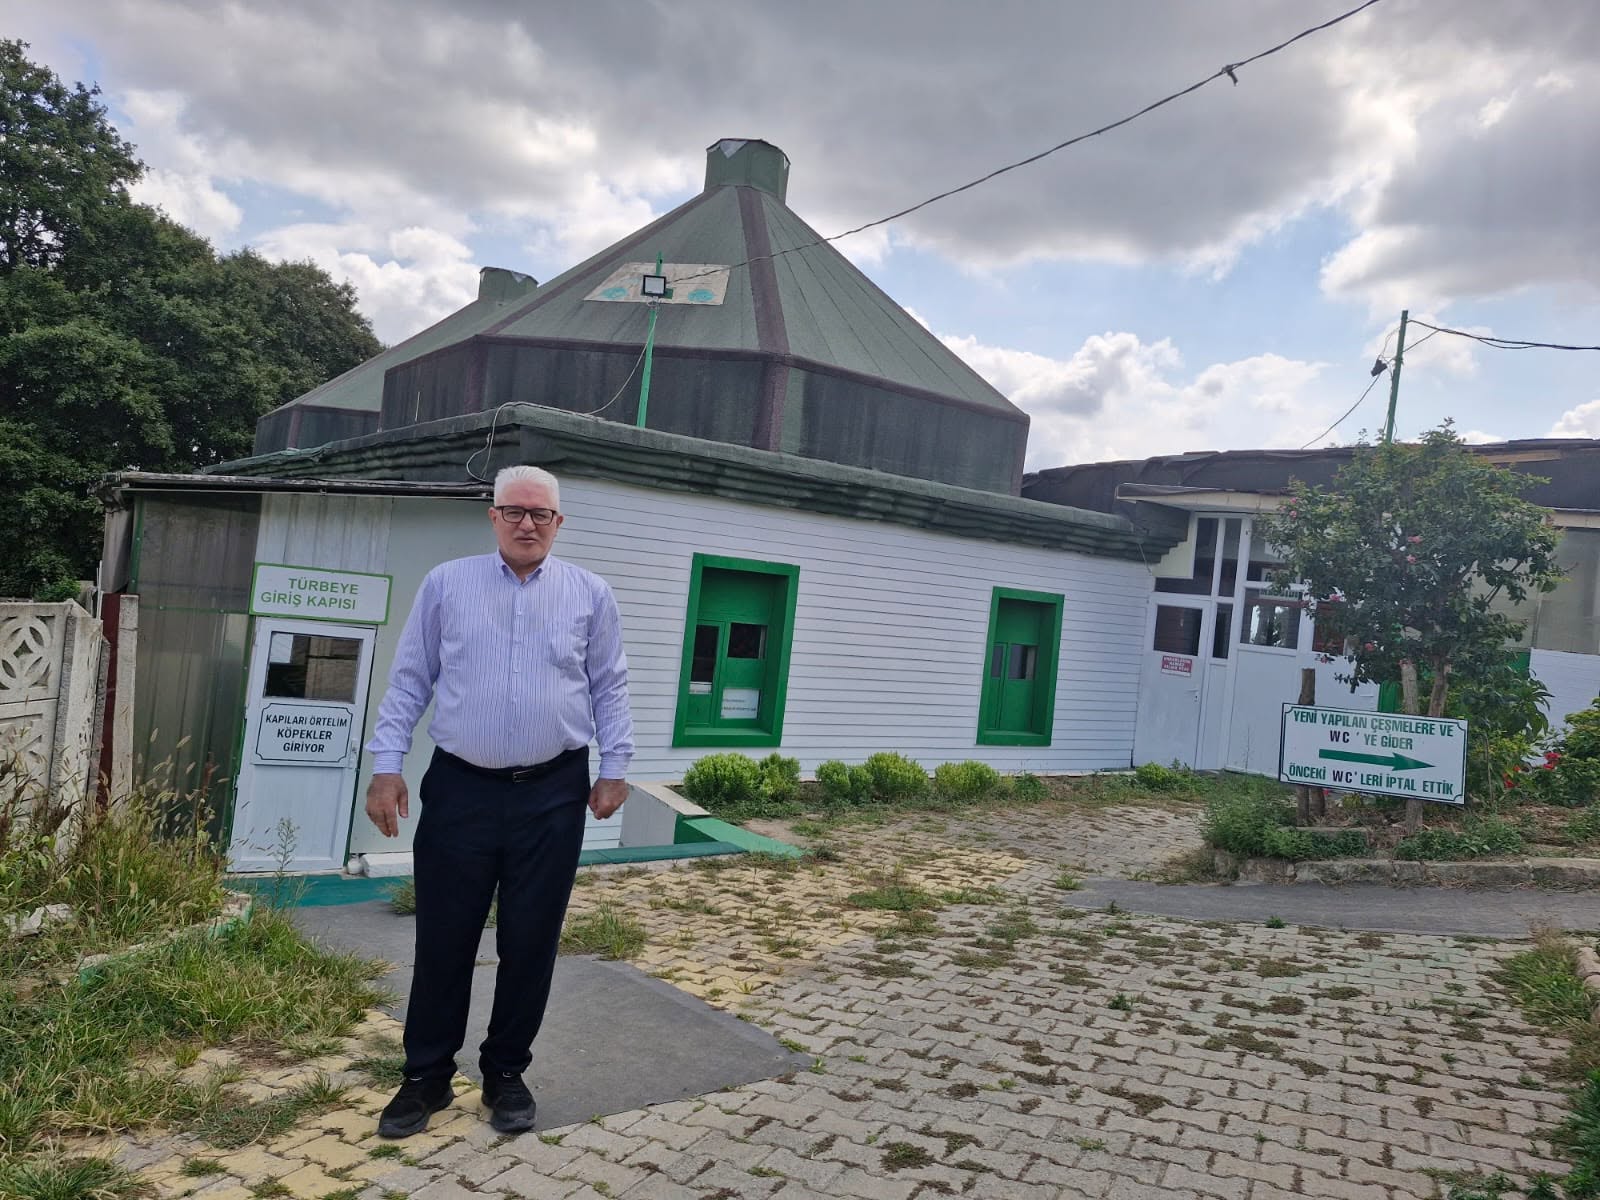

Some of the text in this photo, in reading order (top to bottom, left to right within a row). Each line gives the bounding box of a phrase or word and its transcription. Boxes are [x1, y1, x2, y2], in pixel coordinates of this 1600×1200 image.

[288, 577, 359, 595] TÜRBEYE
[260, 590, 356, 610] GİRİŞ KAPISI
[265, 714, 307, 726] KAPILARI
[1293, 709, 1454, 737] YENİ YAPILAN ÇEŞMELERE VE
[277, 726, 333, 740] KÖPEKLER
[283, 740, 325, 753] GİRİYOR
[1380, 734, 1413, 750] GİDER
[1288, 762, 1326, 780] ÖNCEKİ
[1386, 775, 1417, 791] İPTAL
[1422, 779, 1454, 795] ETTİK
